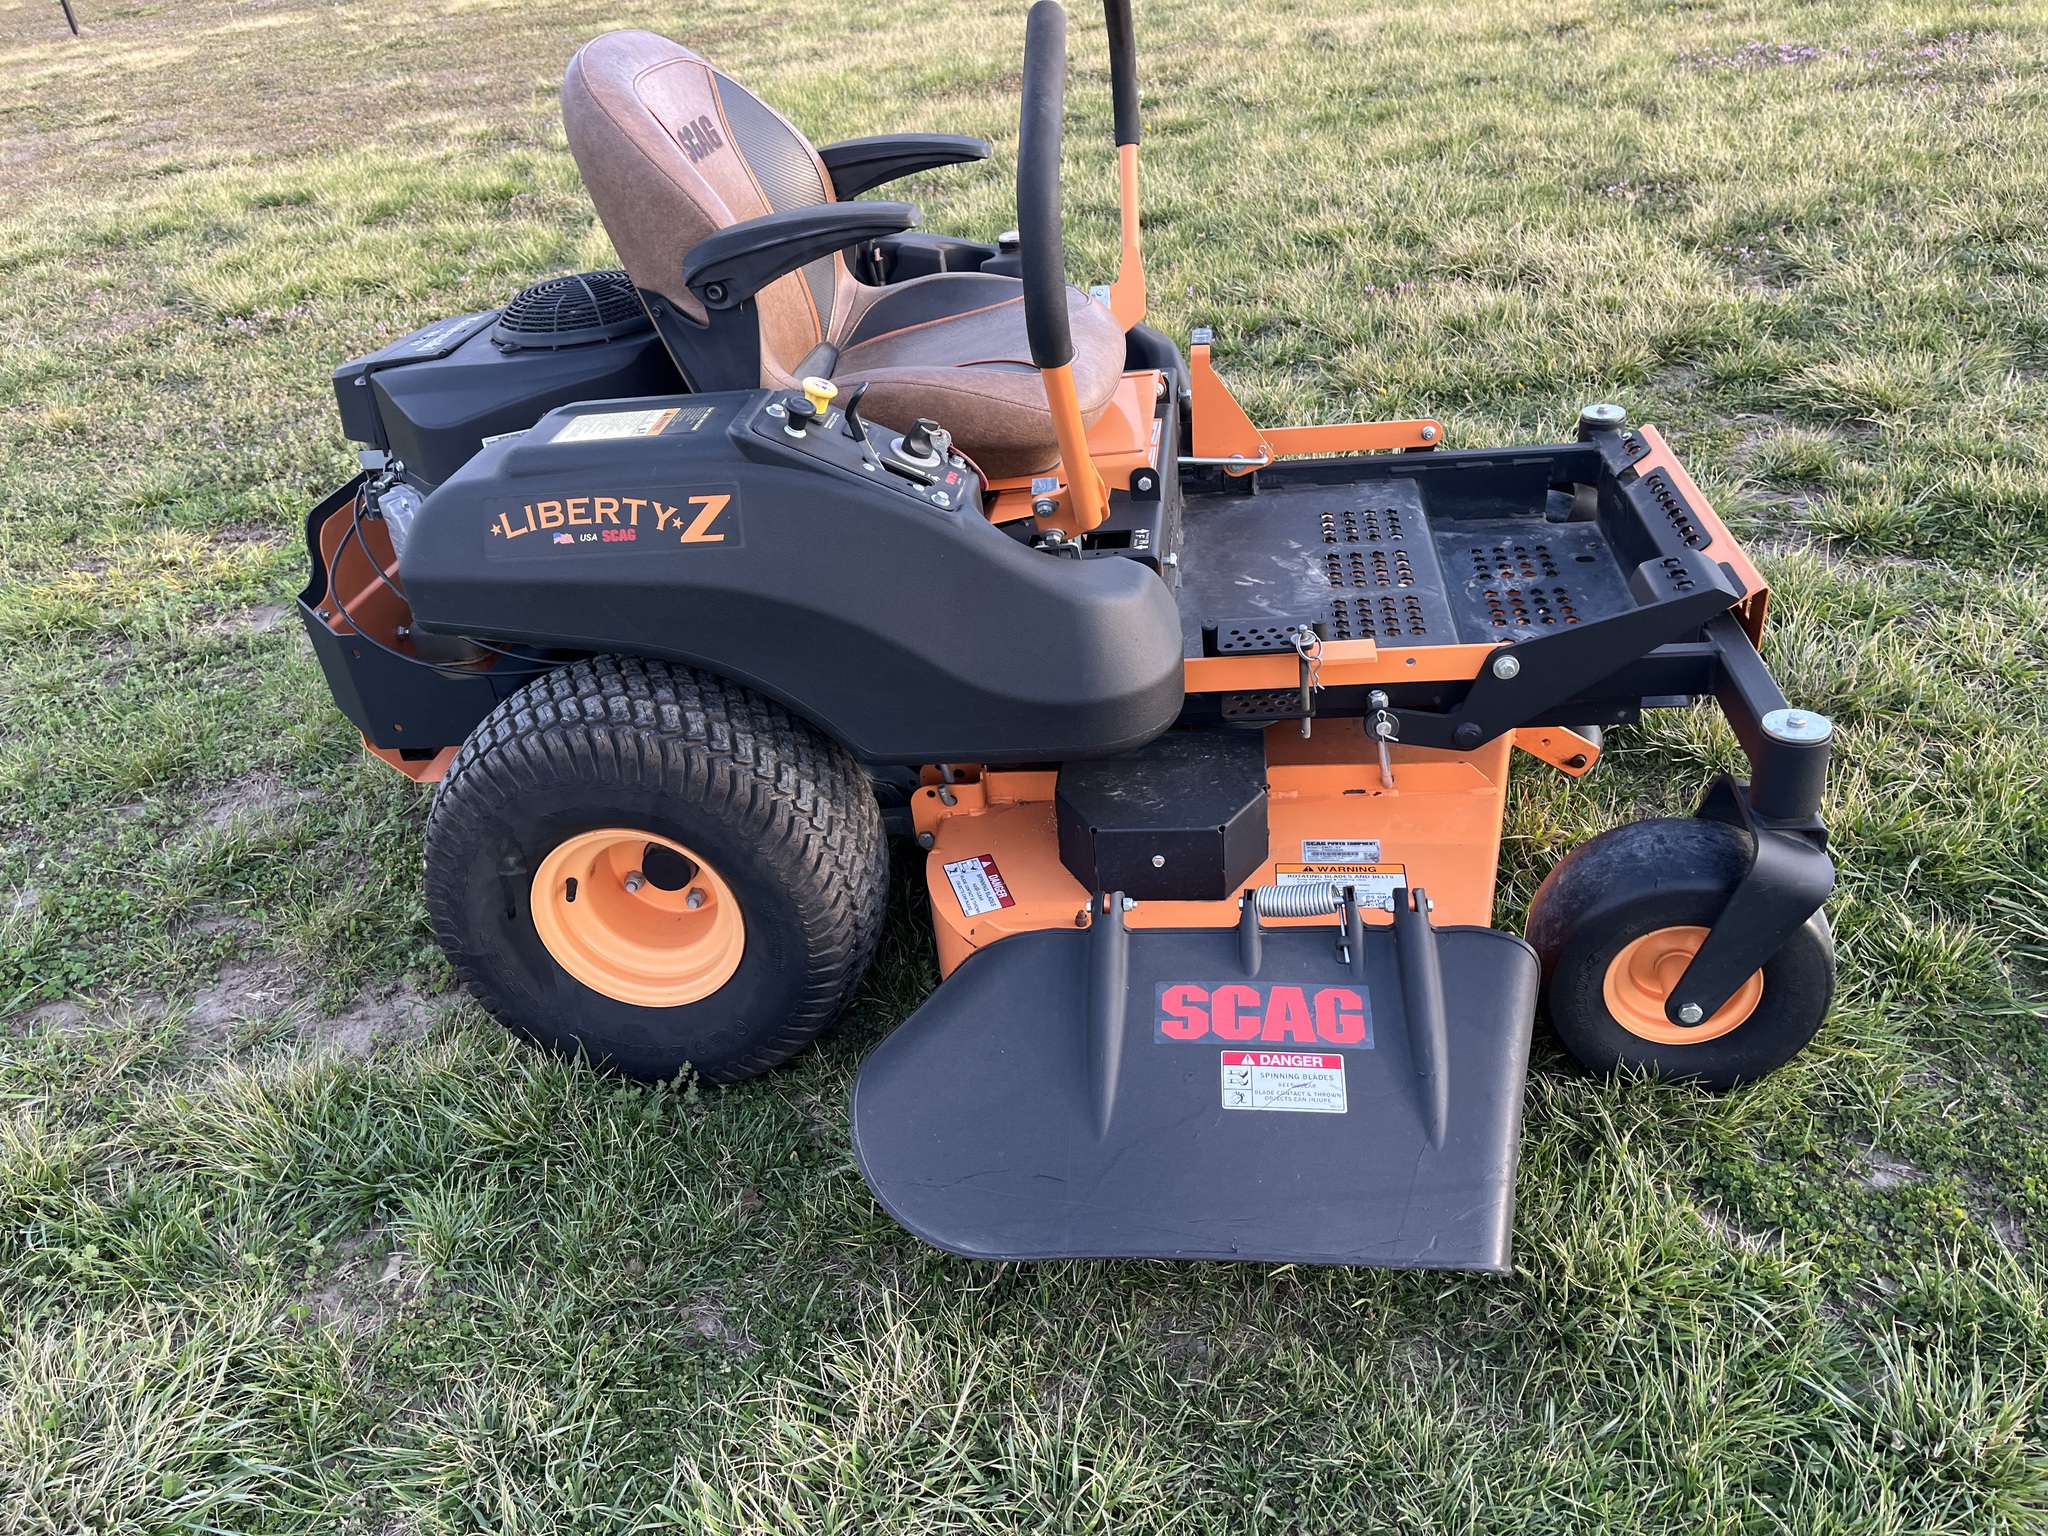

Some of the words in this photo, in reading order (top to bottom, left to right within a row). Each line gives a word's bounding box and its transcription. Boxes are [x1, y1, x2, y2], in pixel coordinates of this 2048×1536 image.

[677, 114, 724, 164] SCAG
[498, 496, 678, 540] LIBERTY
[680, 494, 731, 543] Z
[580, 532, 598, 542] USA
[602, 528, 636, 542] SCAG
[977, 874, 989, 891] SPINNING
[985, 892, 996, 906] BLADES
[988, 874, 1007, 898] DANGER
[1160, 984, 1366, 1044] SCAG
[1260, 1054, 1323, 1067] DANGER
[1260, 1072, 1300, 1080] SPINNING
